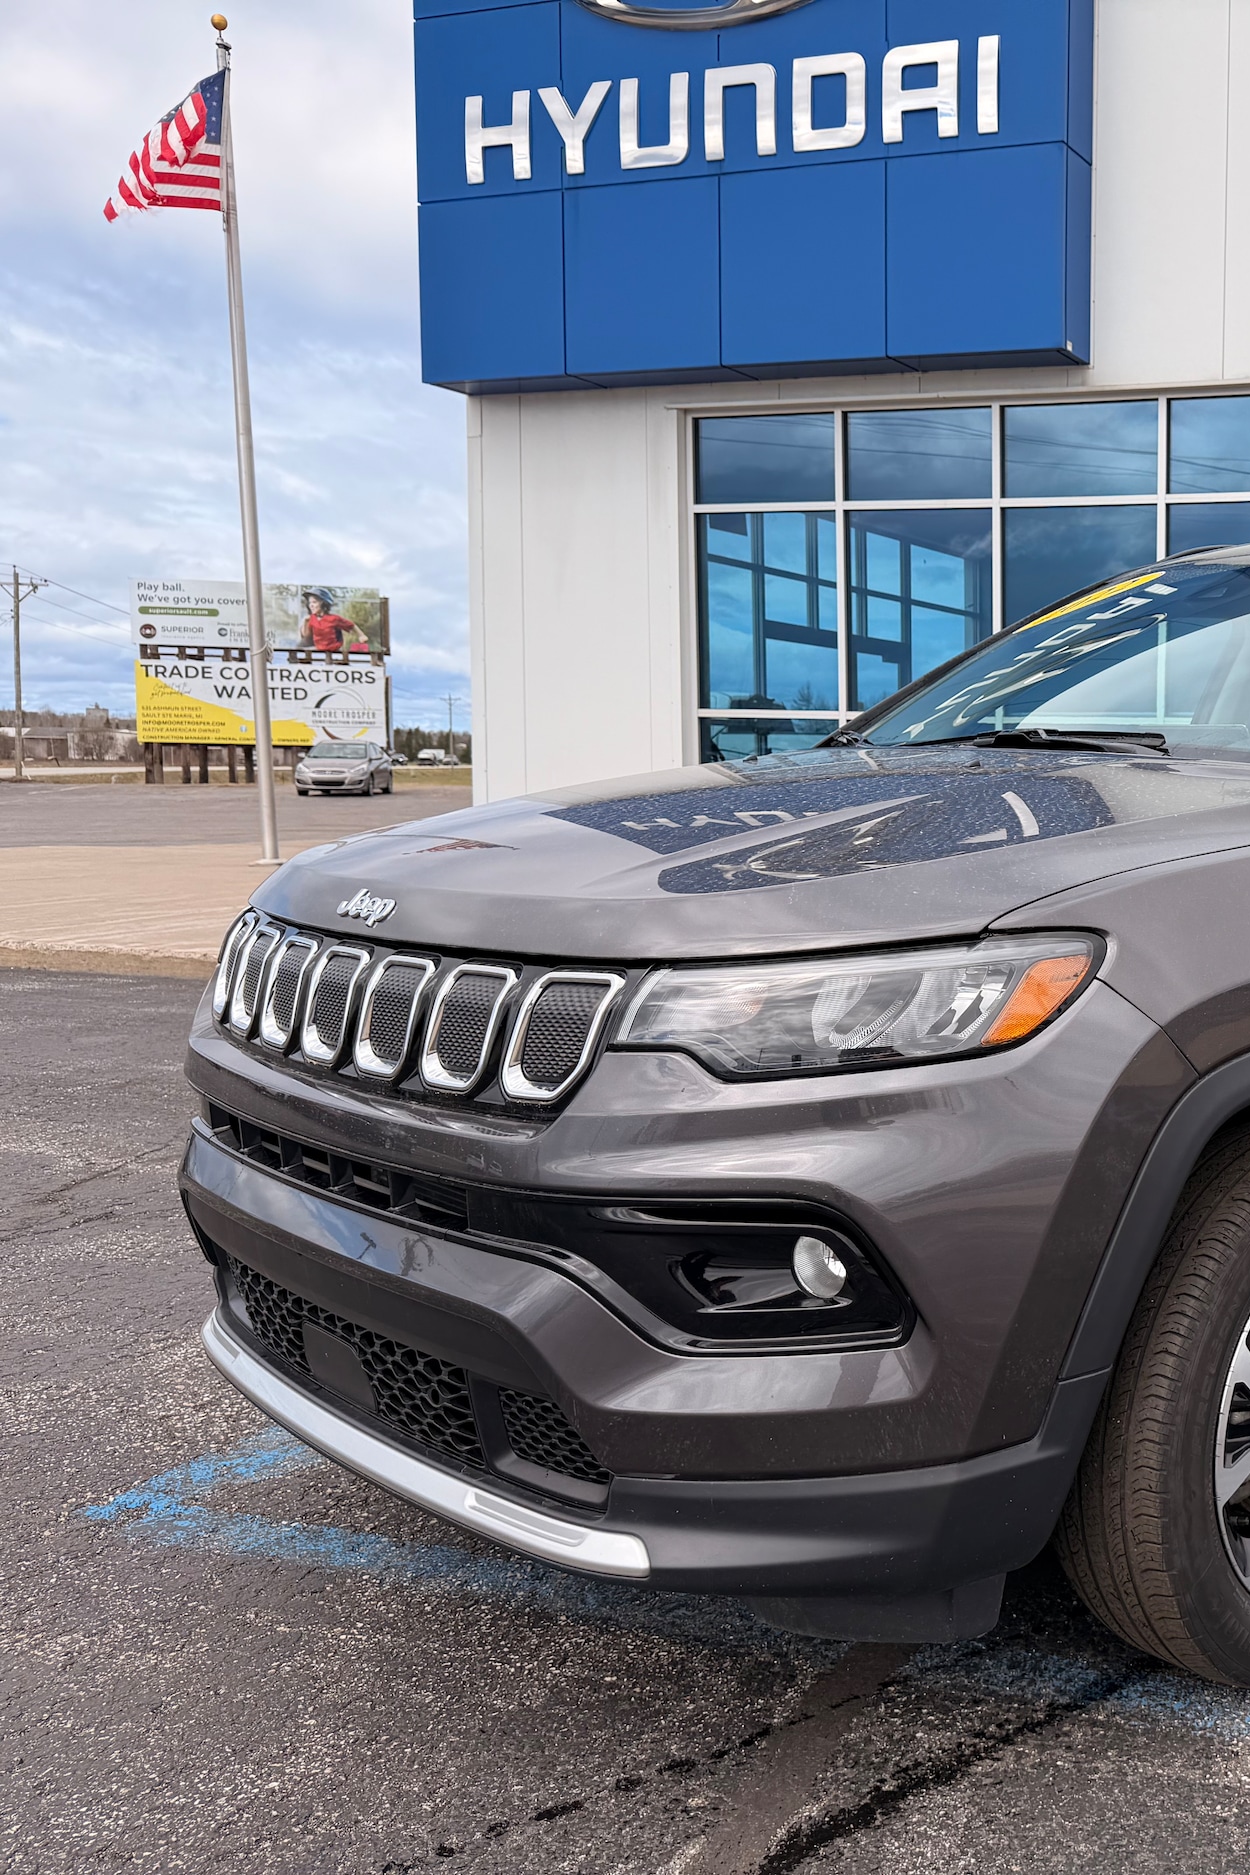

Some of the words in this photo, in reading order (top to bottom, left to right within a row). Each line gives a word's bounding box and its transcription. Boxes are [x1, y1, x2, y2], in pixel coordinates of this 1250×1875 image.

[464, 35, 1000, 185] HYUNDAI
[137, 582, 159, 592] Play
[162, 583, 185, 592] ball.
[137, 593, 170, 603] We've
[173, 595, 191, 605] got
[194, 596, 214, 605] you
[140, 664, 213, 679] TRADE
[220, 666, 376, 684] COTRACTORS
[214, 685, 307, 700] WATED
[311, 710, 337, 718] MOORE
[341, 711, 376, 719] TROSPER
[336, 888, 397, 928] Jeep
